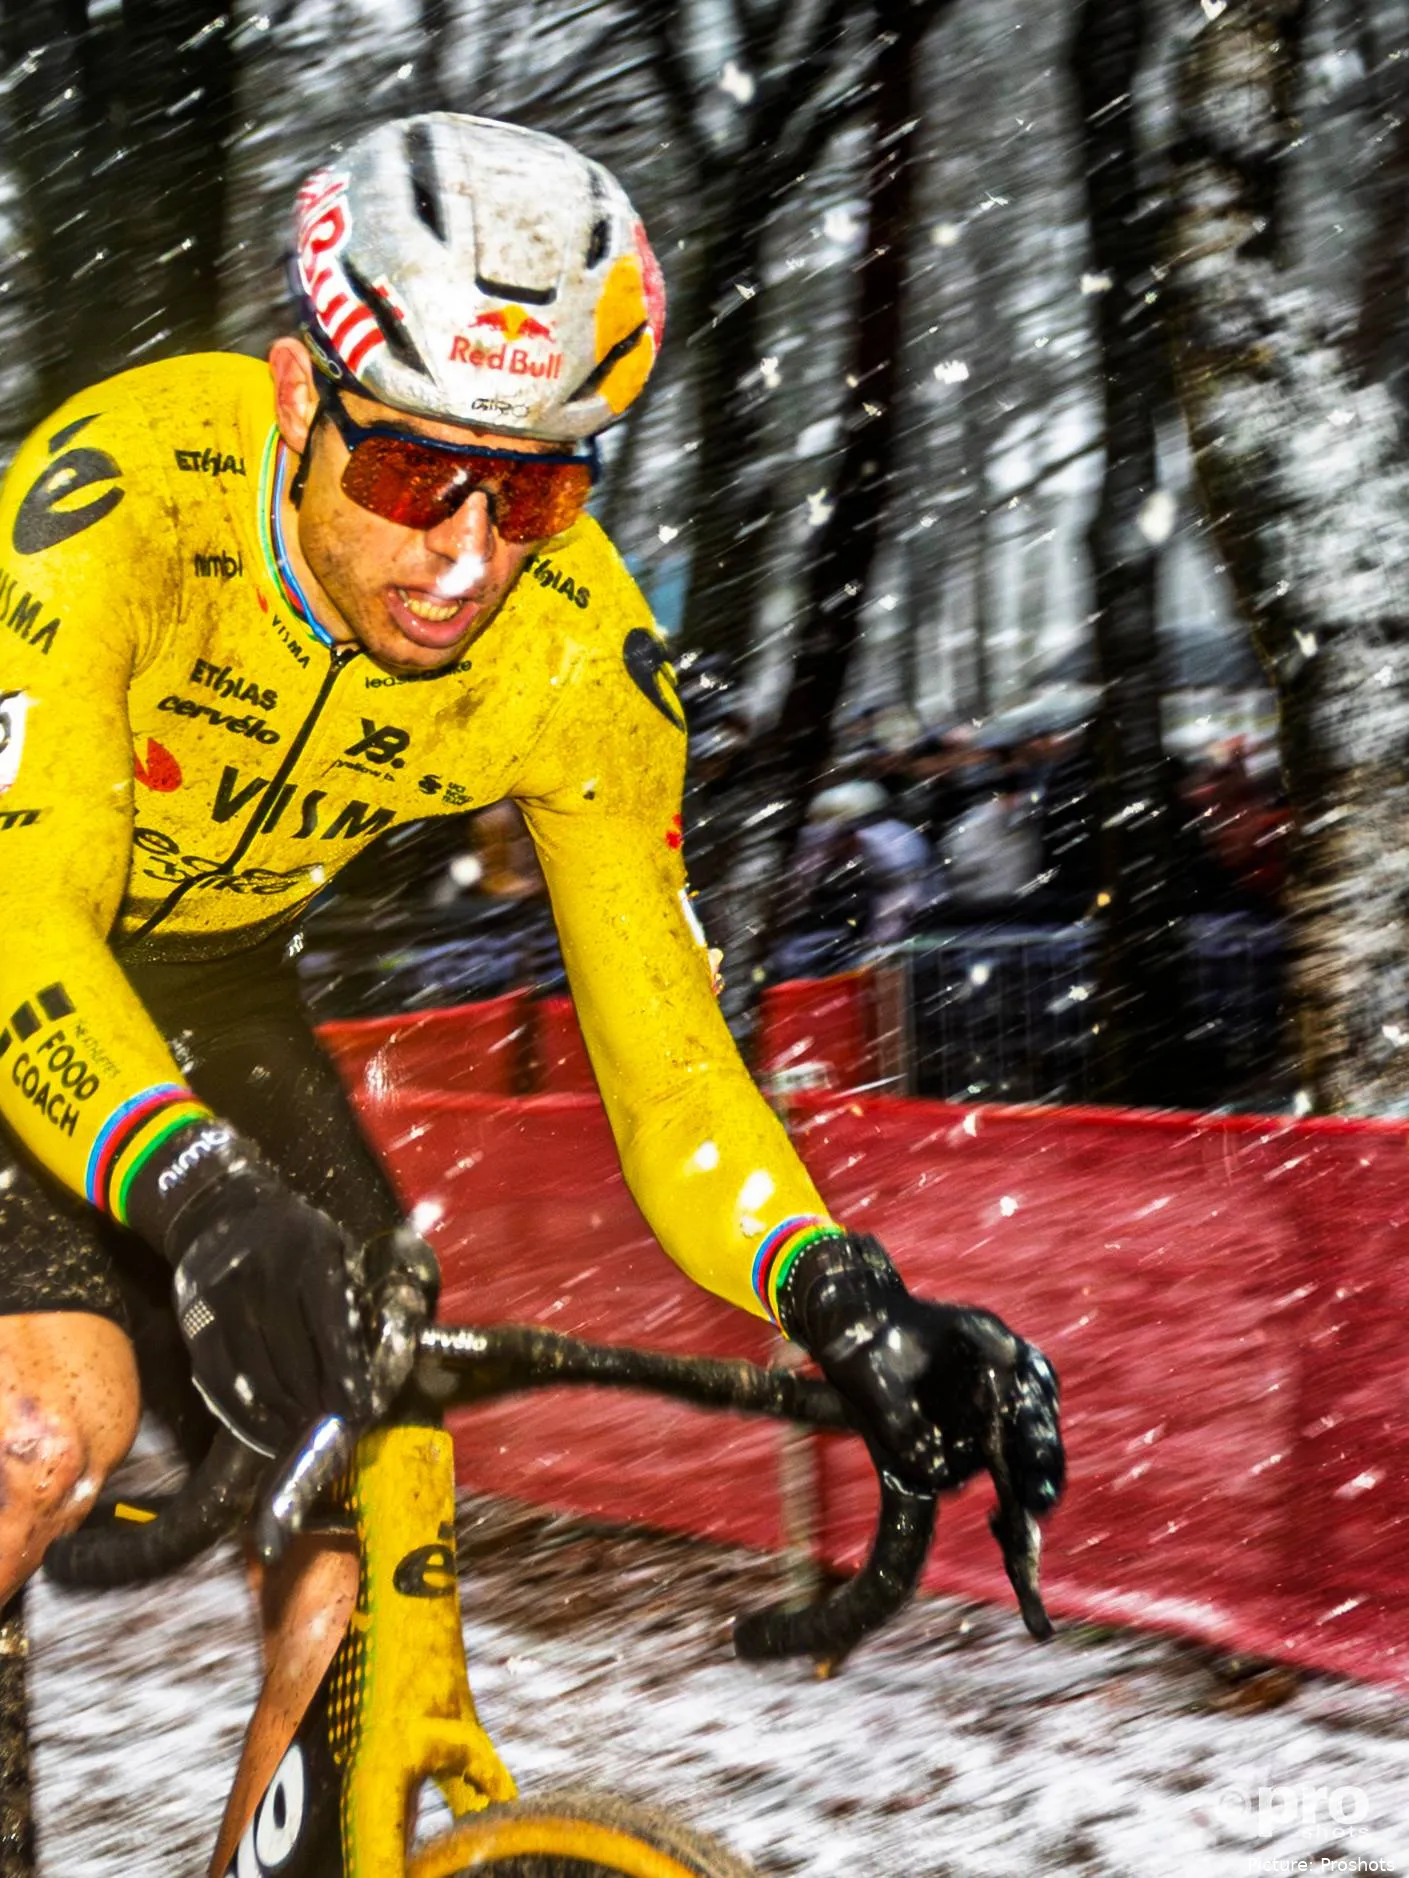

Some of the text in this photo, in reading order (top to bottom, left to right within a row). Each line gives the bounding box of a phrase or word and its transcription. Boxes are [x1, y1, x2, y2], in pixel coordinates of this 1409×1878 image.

[449, 336, 564, 380] Red Bull
[272, 613, 311, 669] VISMA
[157, 695, 282, 746] cervélo
[210, 765, 397, 841] VISM
[12, 1052, 81, 1137] COACH
